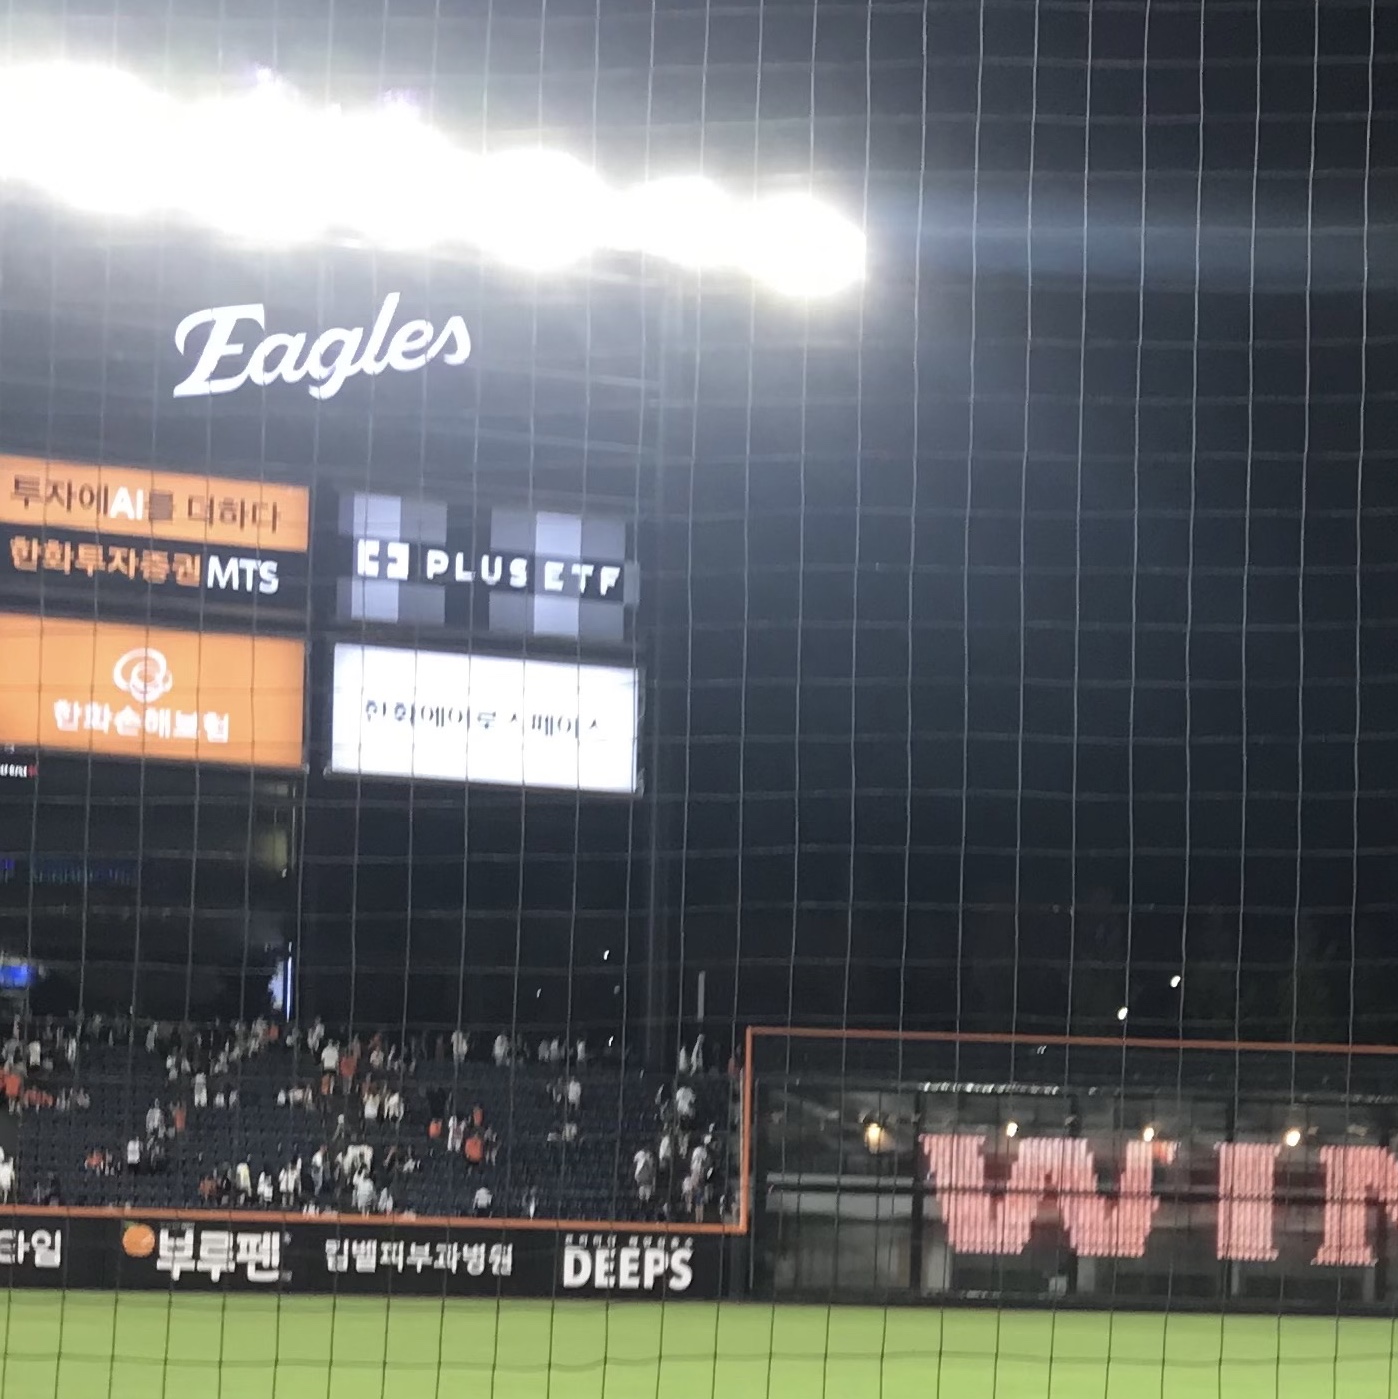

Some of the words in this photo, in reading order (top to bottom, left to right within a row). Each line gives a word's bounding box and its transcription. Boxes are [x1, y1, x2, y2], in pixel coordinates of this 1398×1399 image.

[173, 292, 472, 399] Eagles
[207, 554, 279, 595] MTS
[427, 549, 528, 587] PLUS
[544, 561, 621, 596] ETF
[157, 1227, 280, 1282] 부루펜
[563, 1246, 693, 1291] DEEPS
